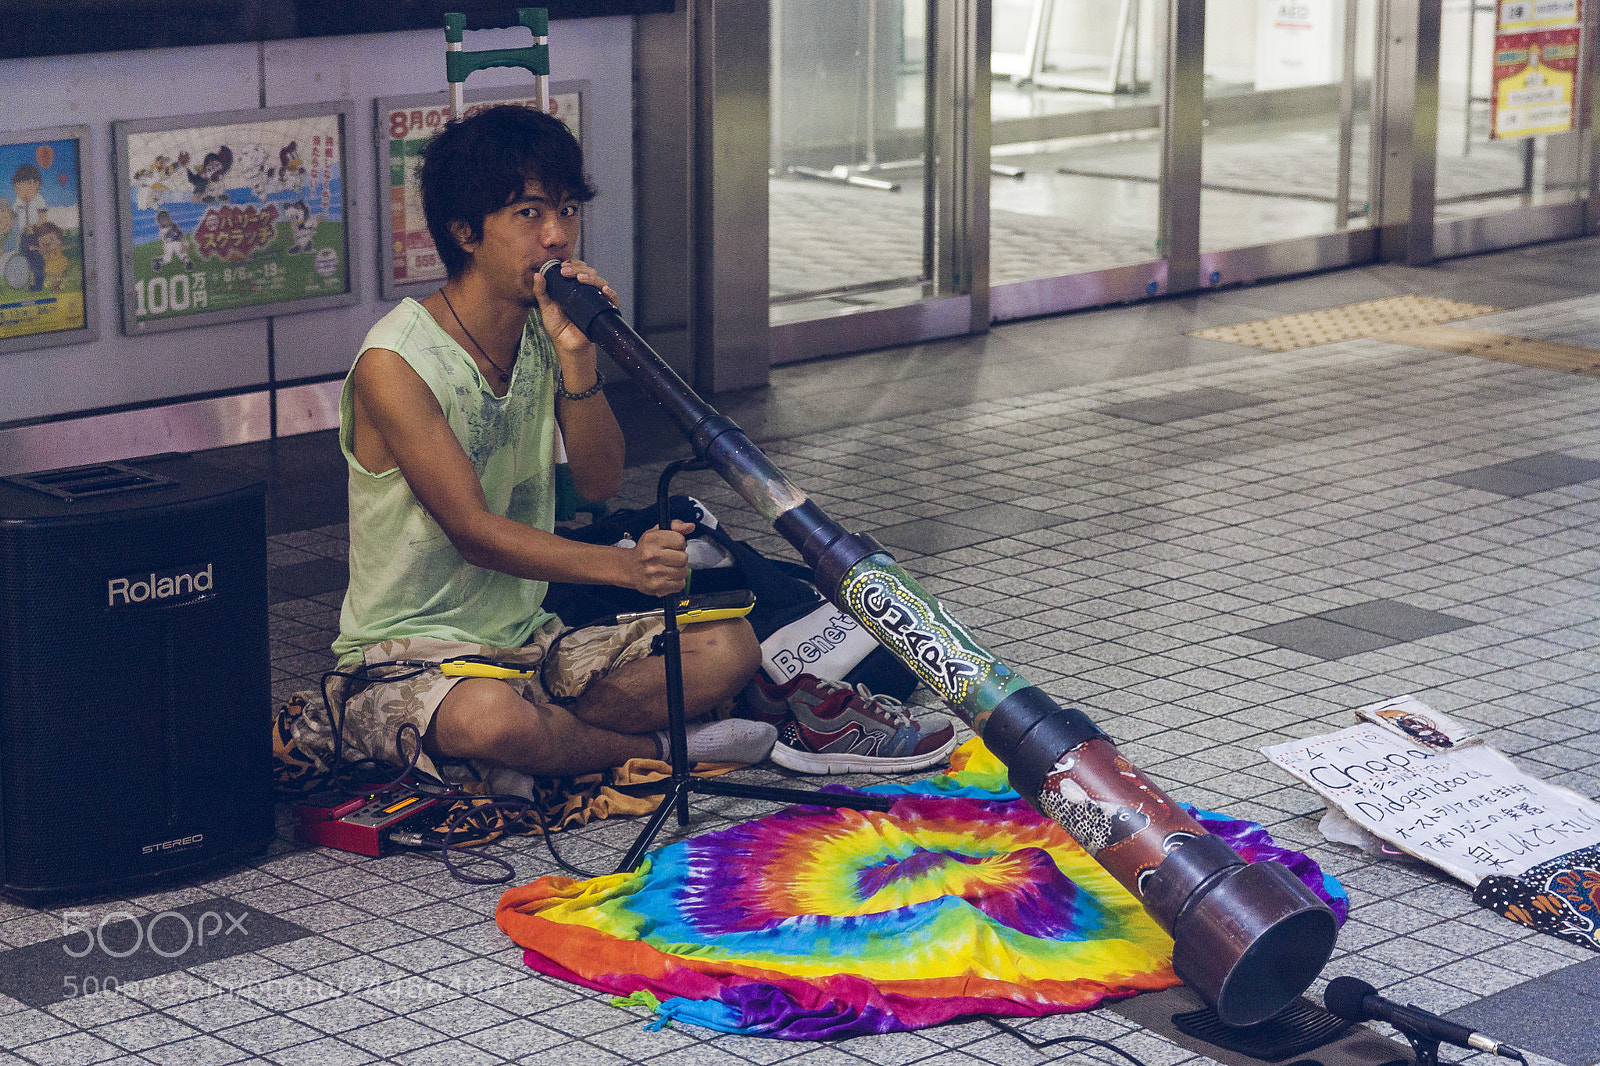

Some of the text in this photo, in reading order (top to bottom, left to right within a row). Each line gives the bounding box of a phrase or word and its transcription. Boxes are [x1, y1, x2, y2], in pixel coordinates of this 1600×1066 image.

[108, 563, 213, 606] Roland
[771, 610, 858, 681] Benet
[1309, 749, 1436, 790] Chapa
[142, 834, 204, 855] STEREO
